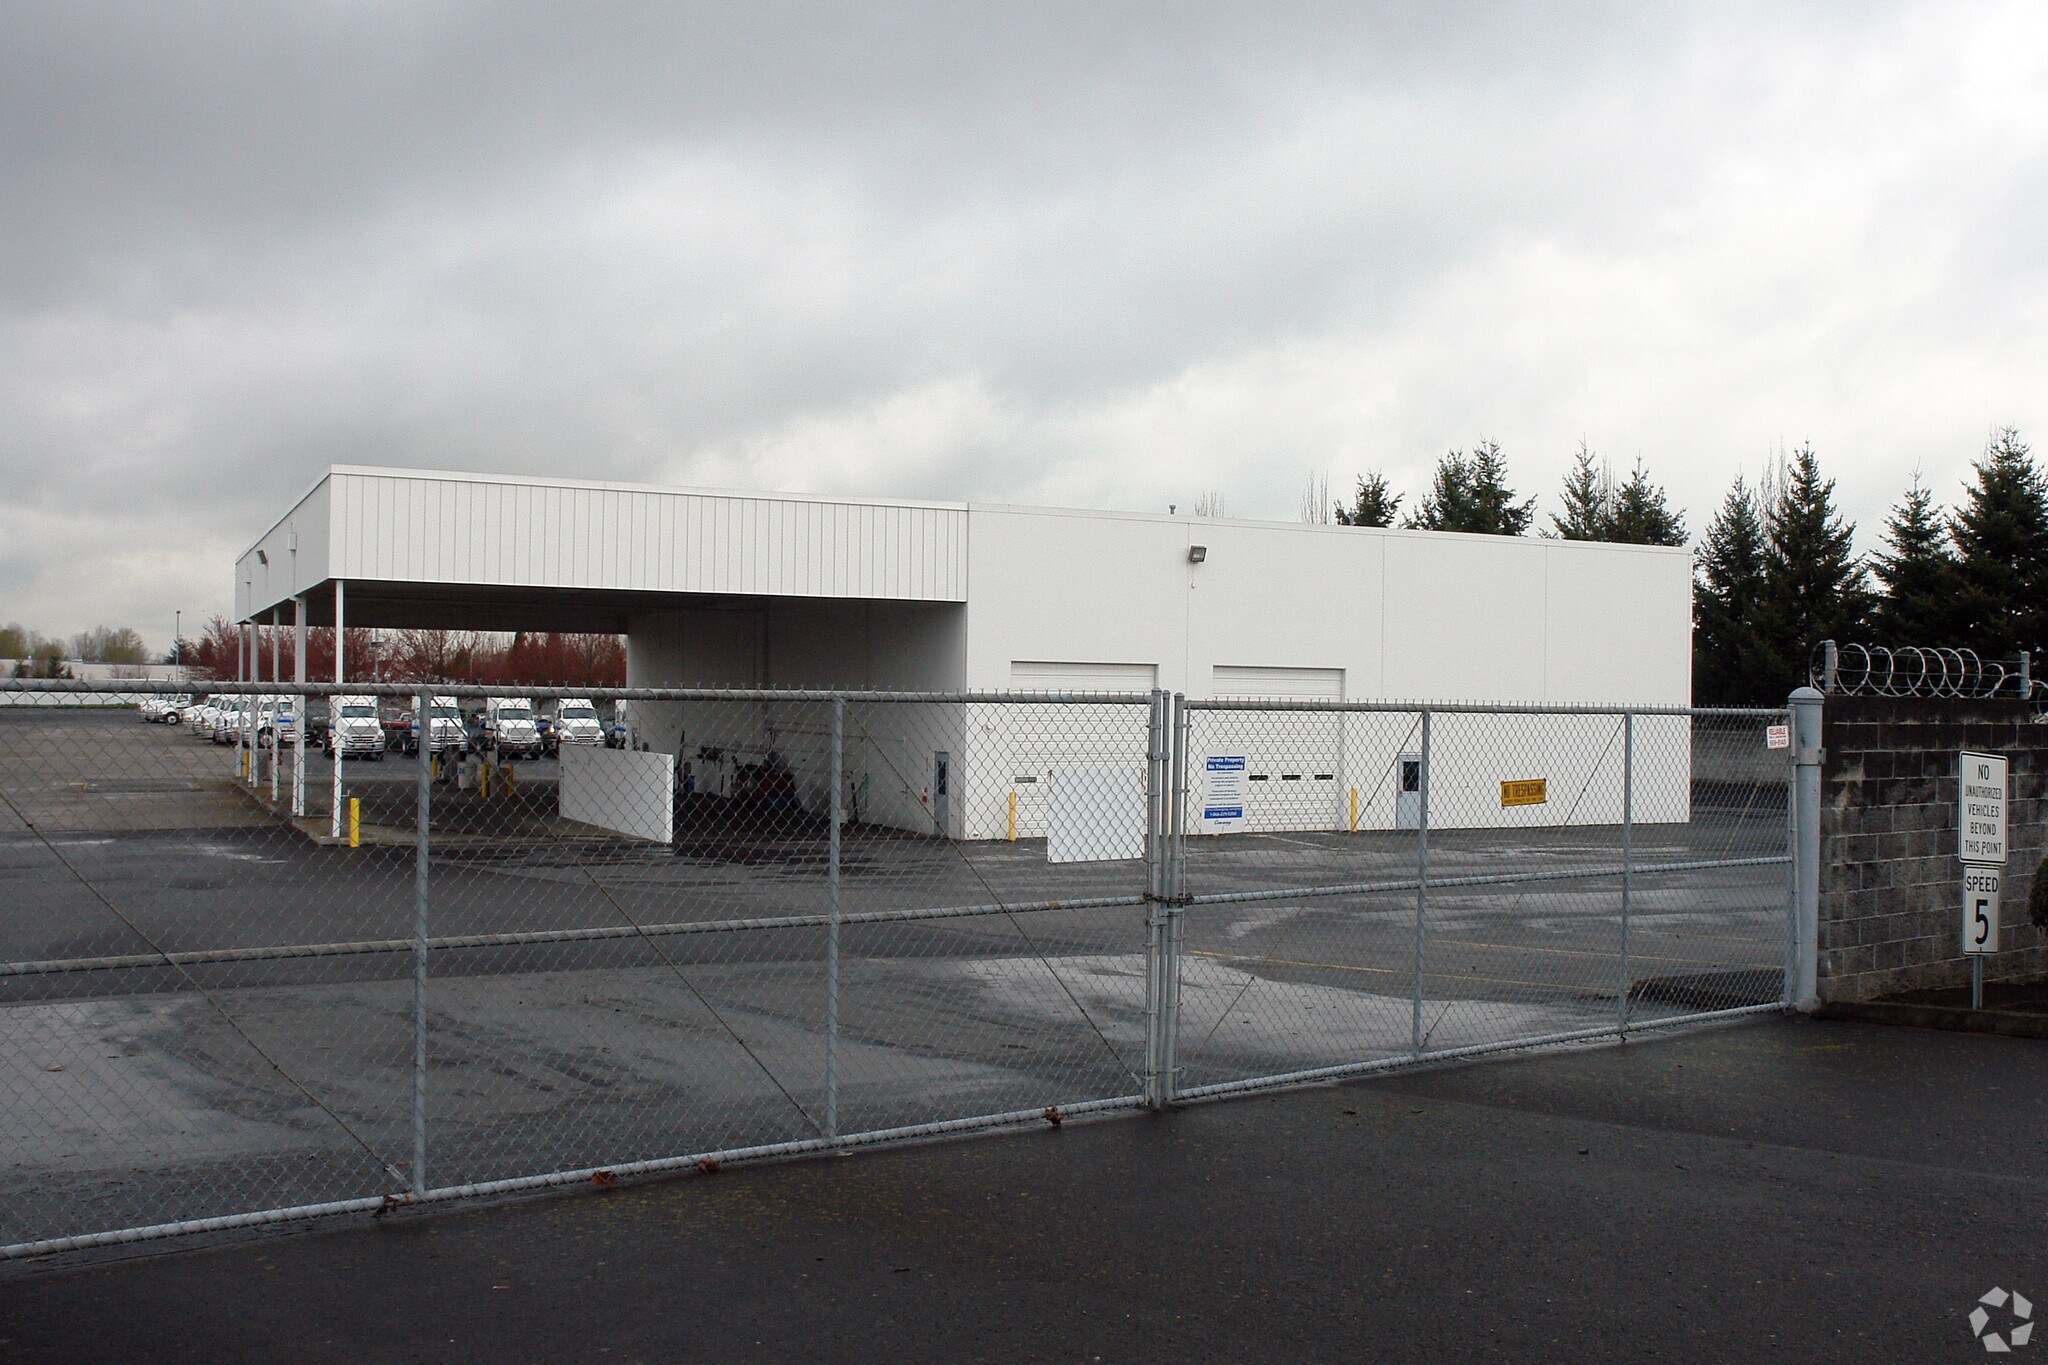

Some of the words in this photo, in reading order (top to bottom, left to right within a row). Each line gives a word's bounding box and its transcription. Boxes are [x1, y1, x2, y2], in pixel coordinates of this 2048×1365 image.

[1977, 764, 1990, 780] NO
[1512, 783, 1544, 798] TRESPASSING
[1965, 785, 2002, 800] UNAUTHORIZED
[1967, 803, 2000, 818] VEHICLES
[1970, 822, 1997, 836] BEYOND
[1965, 840, 1980, 853] THIS
[1981, 841, 2002, 855] POINT
[1966, 876, 1999, 892] SPEED
[1975, 899, 1989, 944] 5
